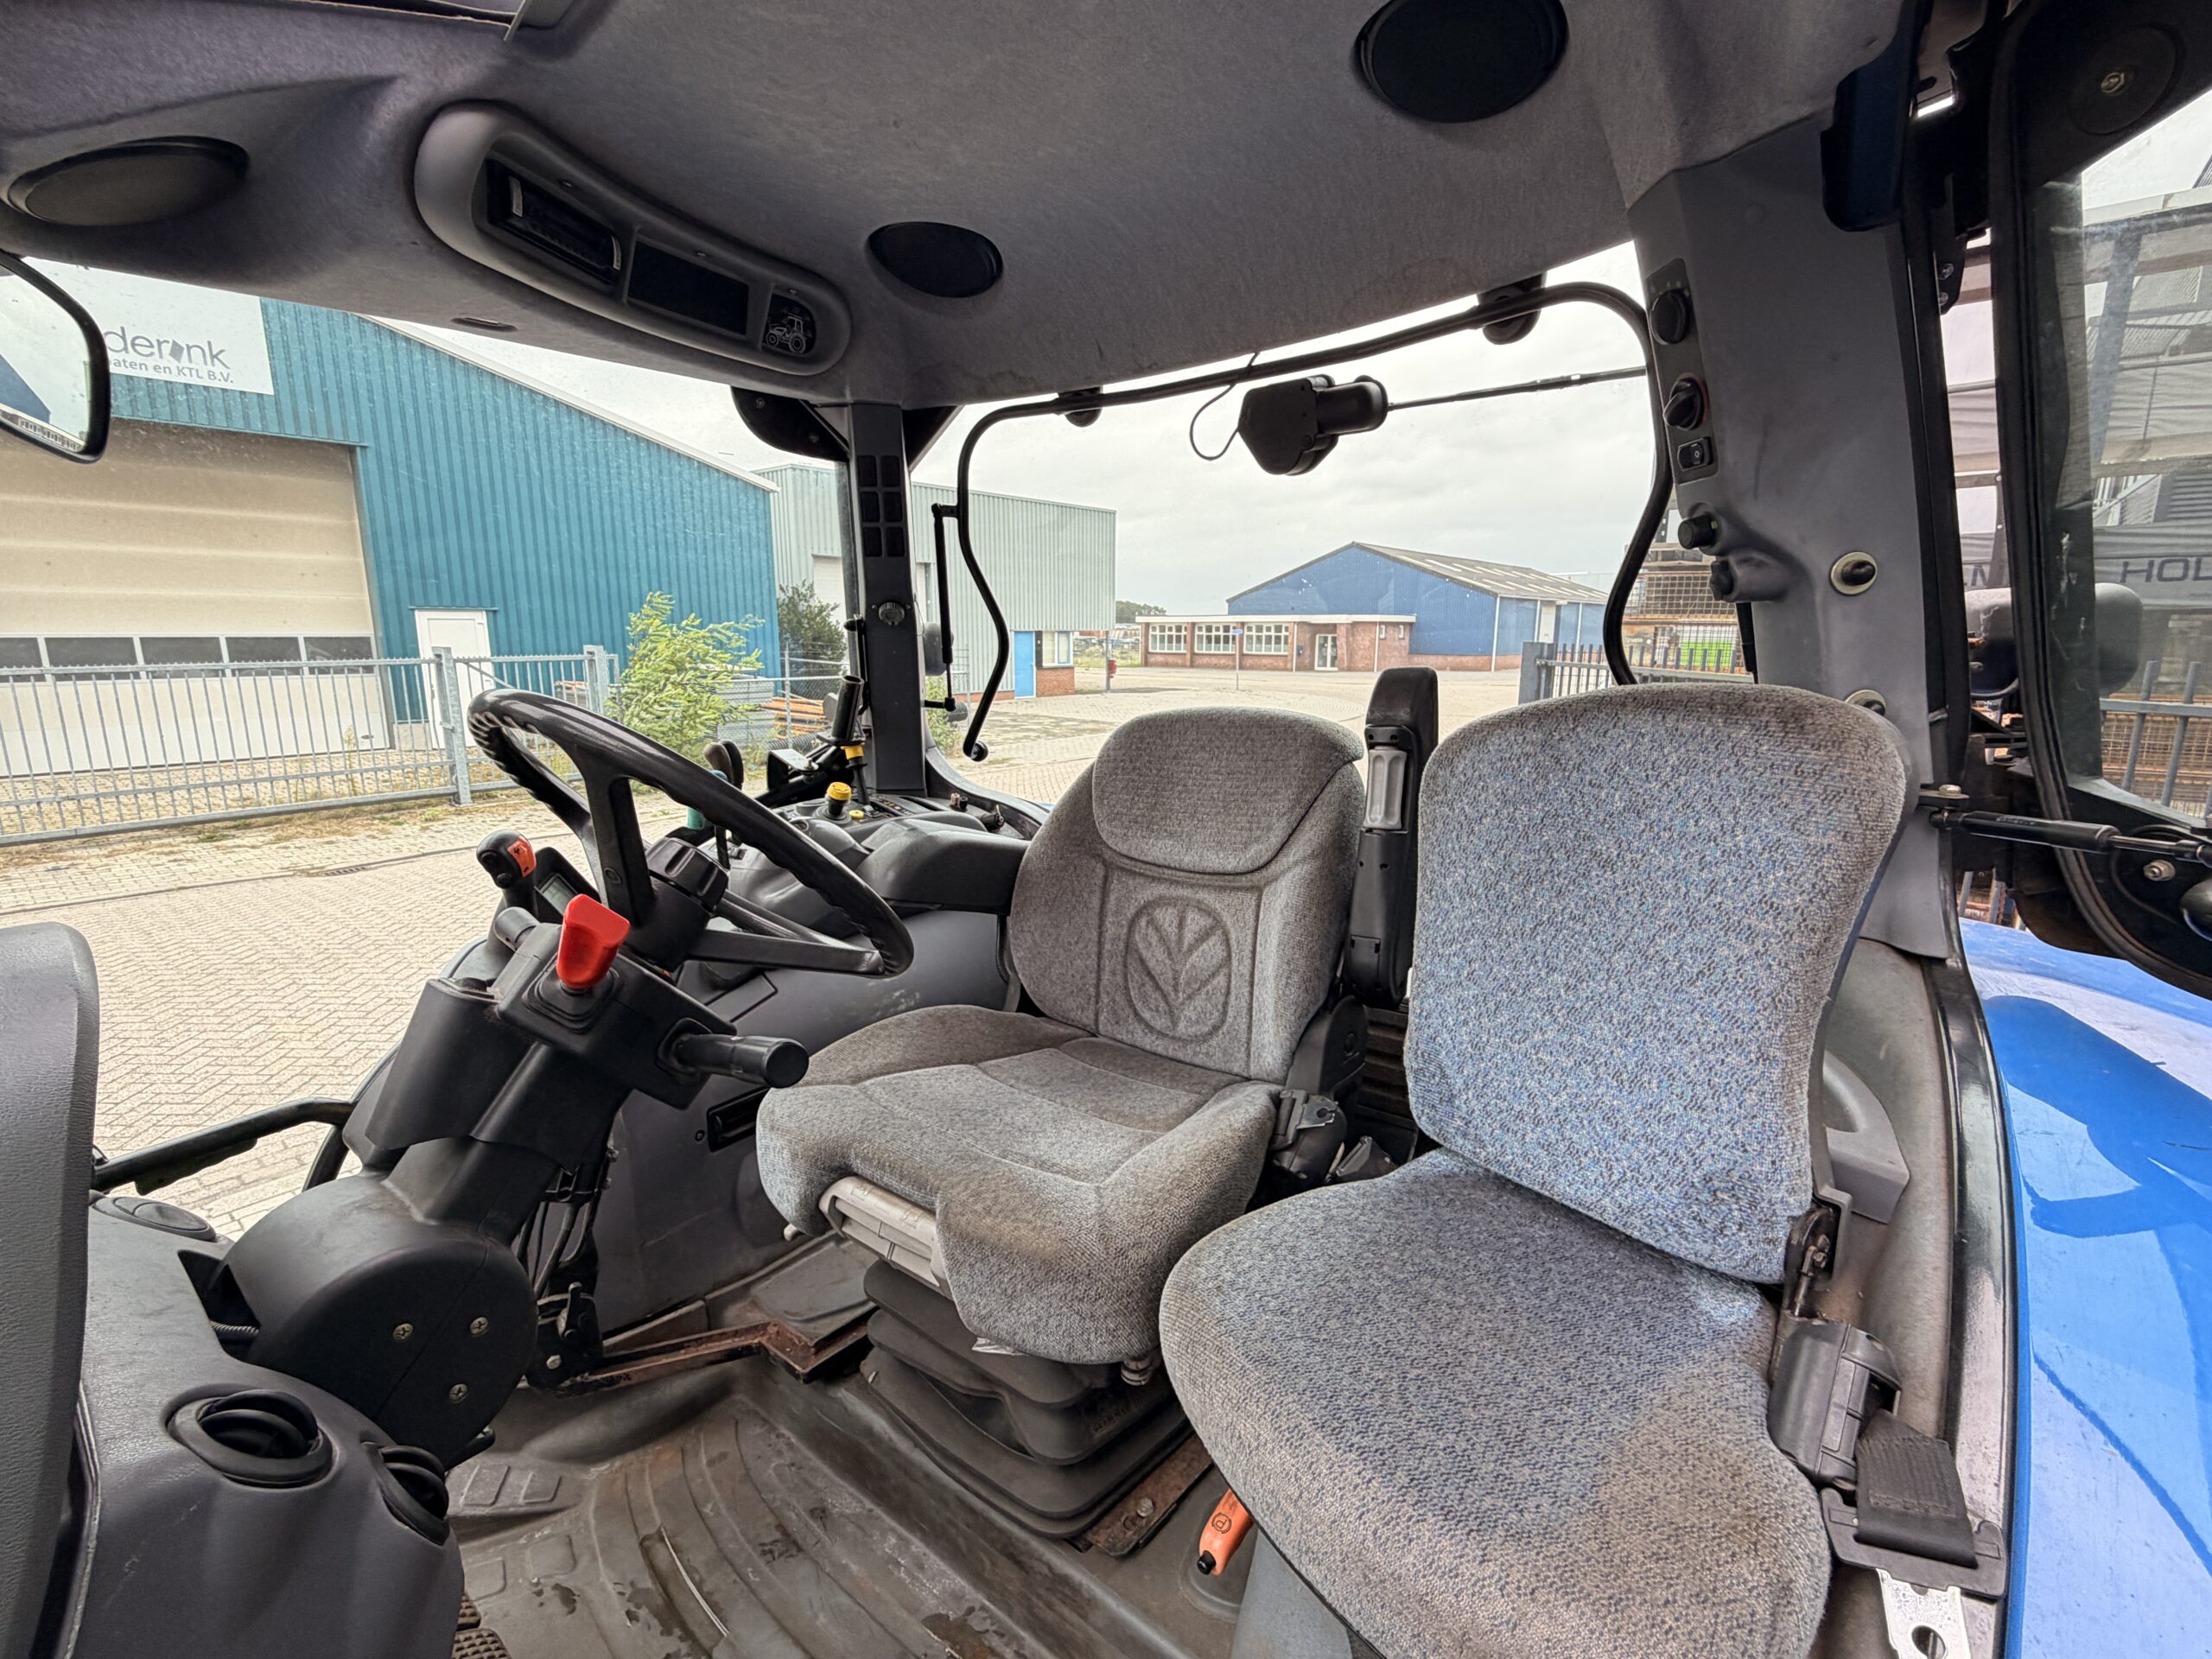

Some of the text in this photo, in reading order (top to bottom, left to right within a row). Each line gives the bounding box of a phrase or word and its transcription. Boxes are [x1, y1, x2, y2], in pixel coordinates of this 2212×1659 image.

[110, 359, 233, 384] aten en KTL B.V.
